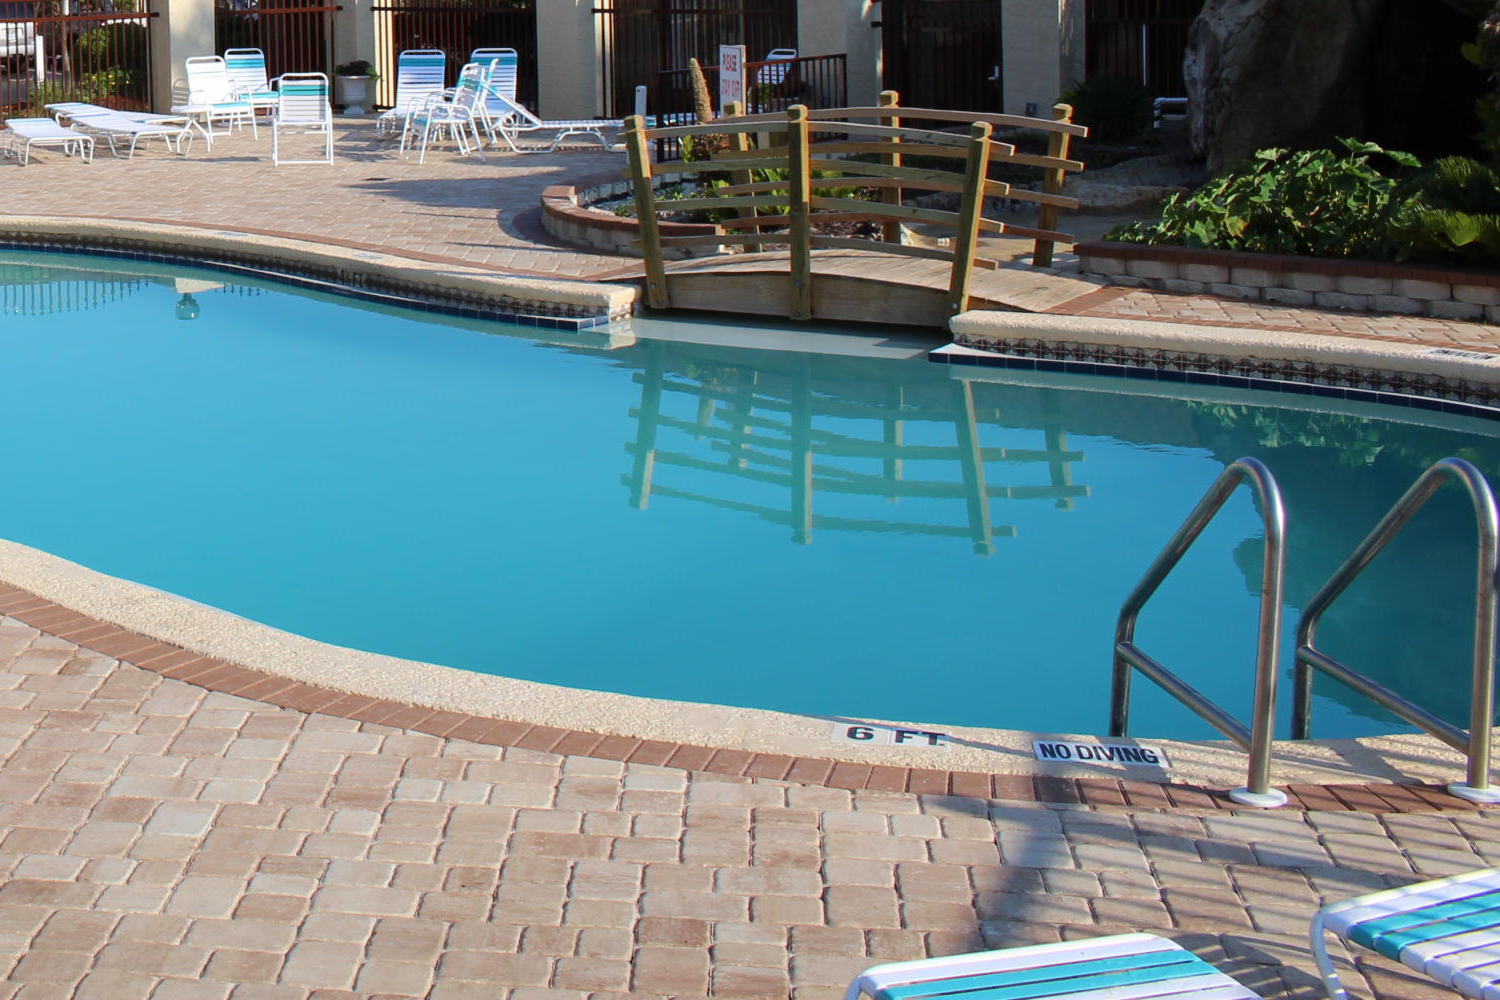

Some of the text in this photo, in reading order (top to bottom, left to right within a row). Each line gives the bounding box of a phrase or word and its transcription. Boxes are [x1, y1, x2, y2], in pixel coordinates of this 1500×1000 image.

[847, 726, 874, 741] 6
[1039, 743, 1160, 764] NO DIVING
